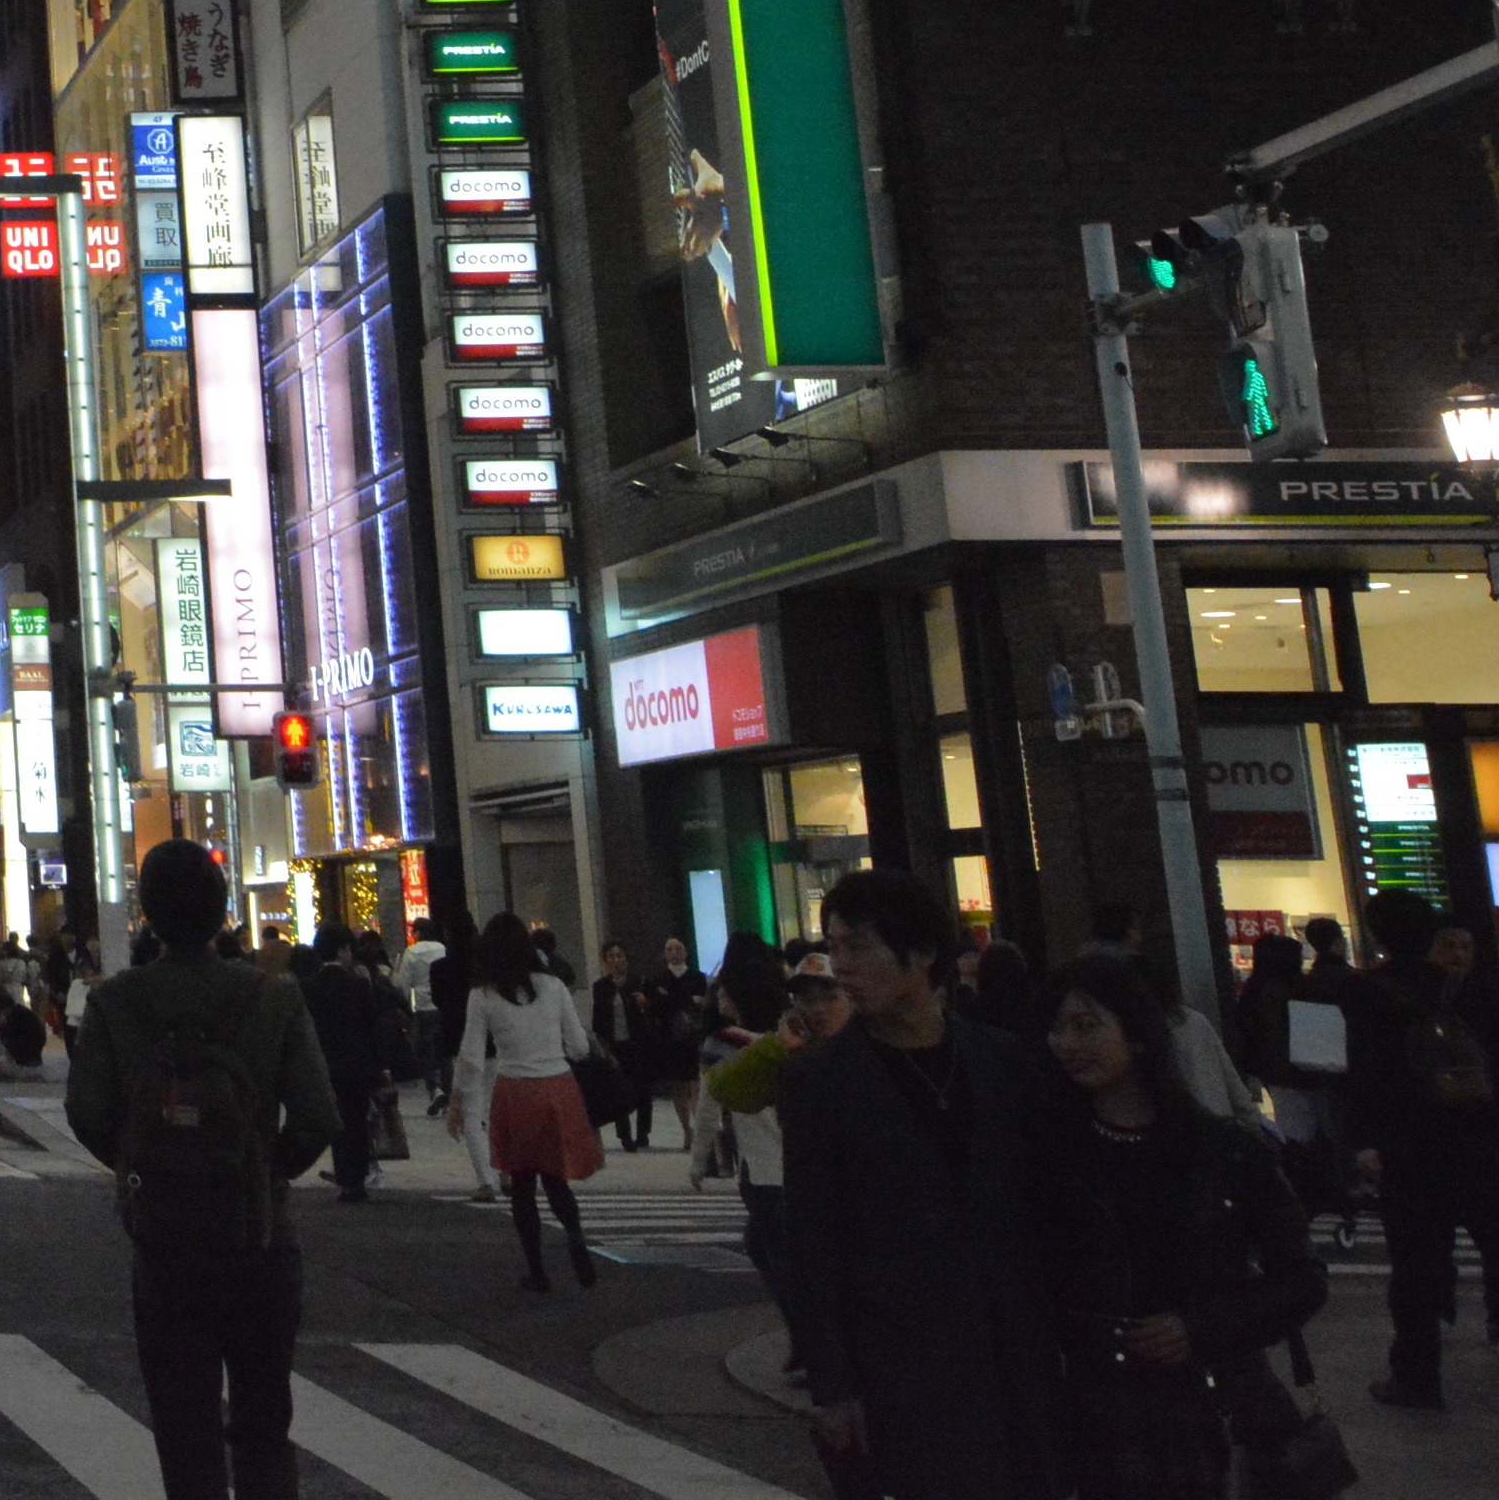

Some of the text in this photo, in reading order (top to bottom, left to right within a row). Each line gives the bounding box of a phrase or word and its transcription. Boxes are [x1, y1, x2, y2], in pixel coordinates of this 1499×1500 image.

[450, 179, 522, 193] docomo
[154, 202, 178, 247] 買取
[6, 226, 49, 247] UNI
[7, 249, 54, 273] QLO
[456, 251, 528, 265] docomo
[462, 323, 535, 337] docomo
[469, 396, 542, 410] docomo
[475, 469, 549, 483] docomo
[174, 548, 205, 673] 岩崎眼鏡店
[624, 682, 700, 731] docomo
[1204, 760, 1296, 786] omo
